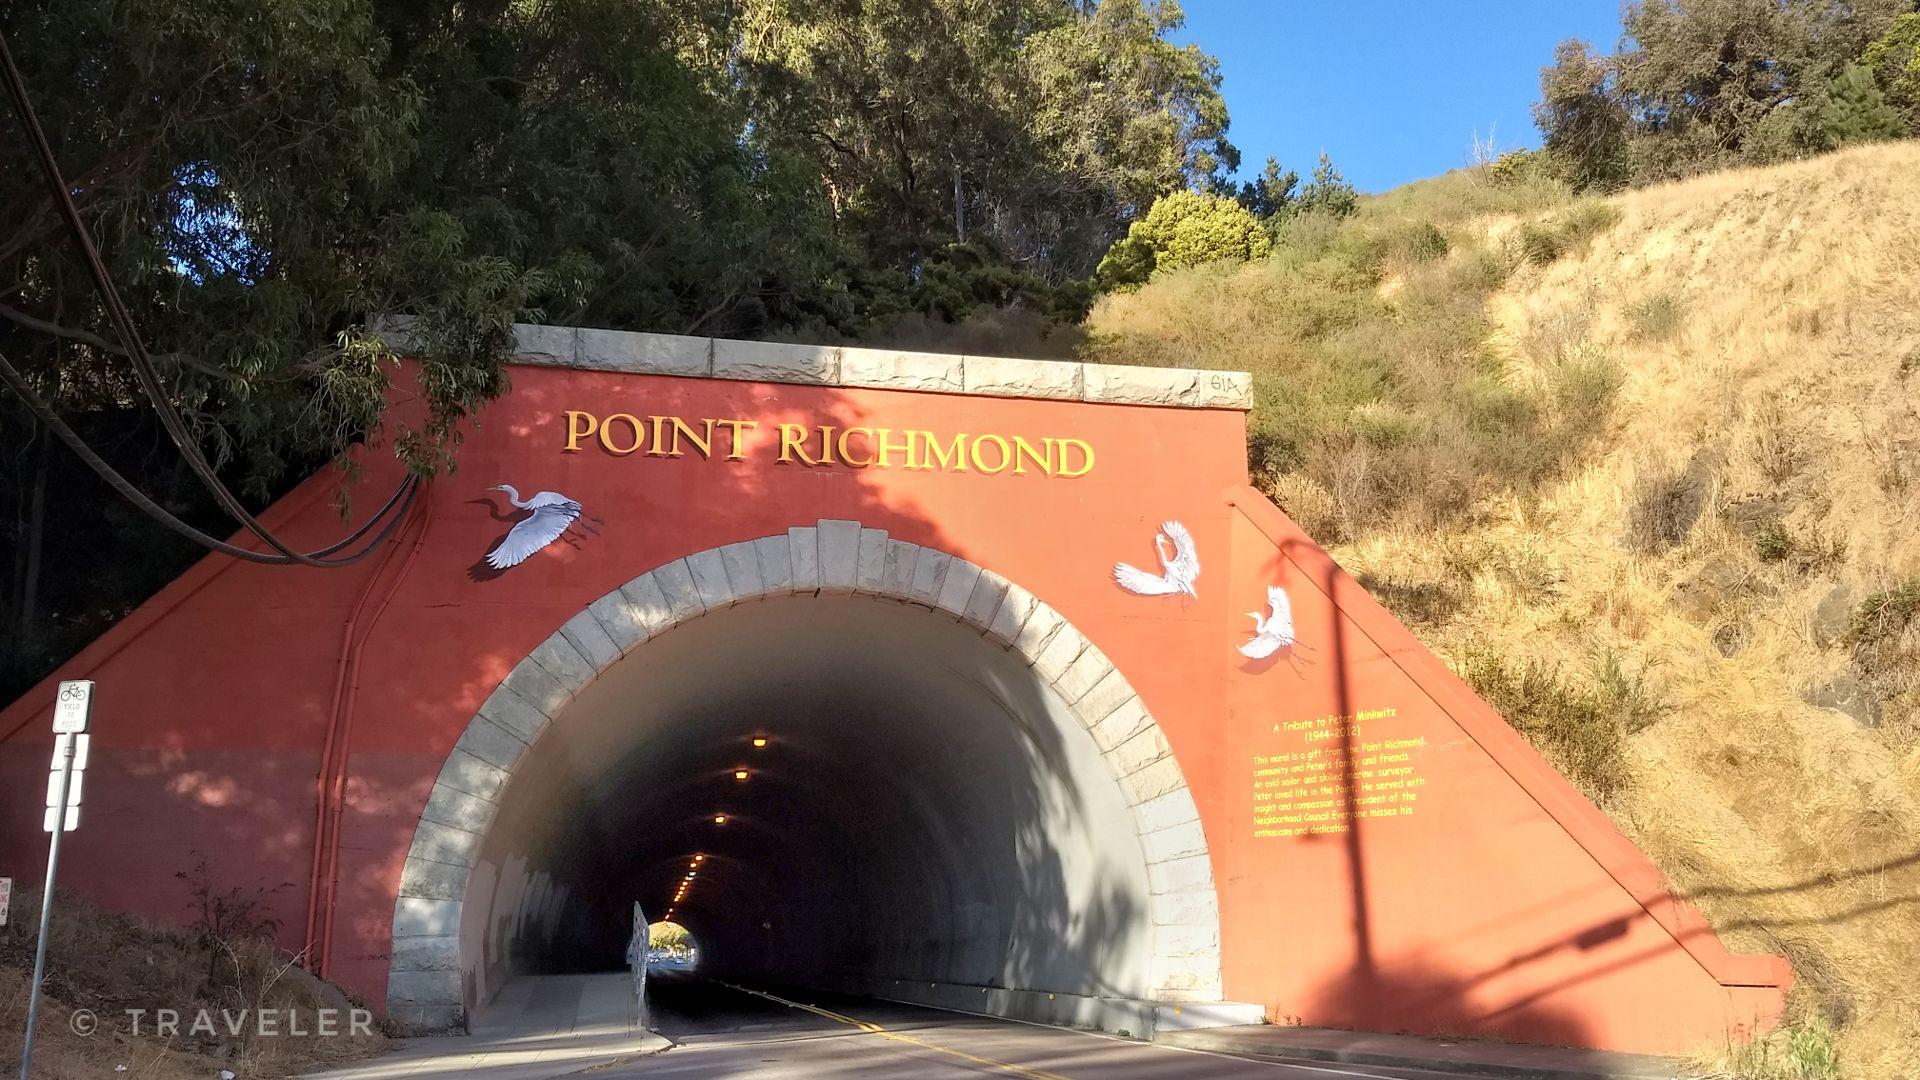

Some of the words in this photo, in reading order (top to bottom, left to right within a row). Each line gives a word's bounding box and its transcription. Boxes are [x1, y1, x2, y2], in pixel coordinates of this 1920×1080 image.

[563, 410, 758, 463] POINT
[777, 423, 1095, 478] RICHMOND
[1282, 720, 1313, 731] Tribute
[1316, 718, 1326, 727] to
[1328, 713, 1352, 725] Peter
[1356, 707, 1397, 721] Minkwitz
[1254, 756, 1268, 765] This
[1270, 753, 1289, 763] mural
[1307, 748, 1322, 761] gift
[1324, 747, 1342, 756] from
[1361, 742, 1382, 752] Point
[1385, 736, 1424, 749] Richmond
[1254, 765, 1289, 777] community
[1291, 763, 1304, 772] and
[1306, 760, 1332, 770] Peter's
[1335, 757, 1358, 769] family
[1362, 755, 1376, 765] and
[1254, 779, 1263, 788] An
[1265, 778, 1279, 787] avid
[1281, 776, 1300, 786] sailor
[1303, 775, 1316, 784] and
[1319, 772, 1342, 782] skilled
[1254, 791, 1272, 800] Peter
[1274, 789, 1294, 799] loved
[1295, 787, 1308, 797] life
[1361, 781, 1374, 791] He
[1375, 778, 1404, 790] served
[1407, 776, 1425, 787] with
[1253, 802, 1277, 814] insight
[1278, 801, 1291, 810] and
[1293, 798, 1334, 810] compassion
[1336, 798, 1345, 807] as
[1389, 791, 1398, 802] of
[1253, 812, 1302, 826] Neighborhood
[1370, 806, 1397, 817] misses
[1400, 806, 1413, 814] his
[1254, 826, 1292, 838] enthusiasm
[1295, 824, 1308, 834] and
